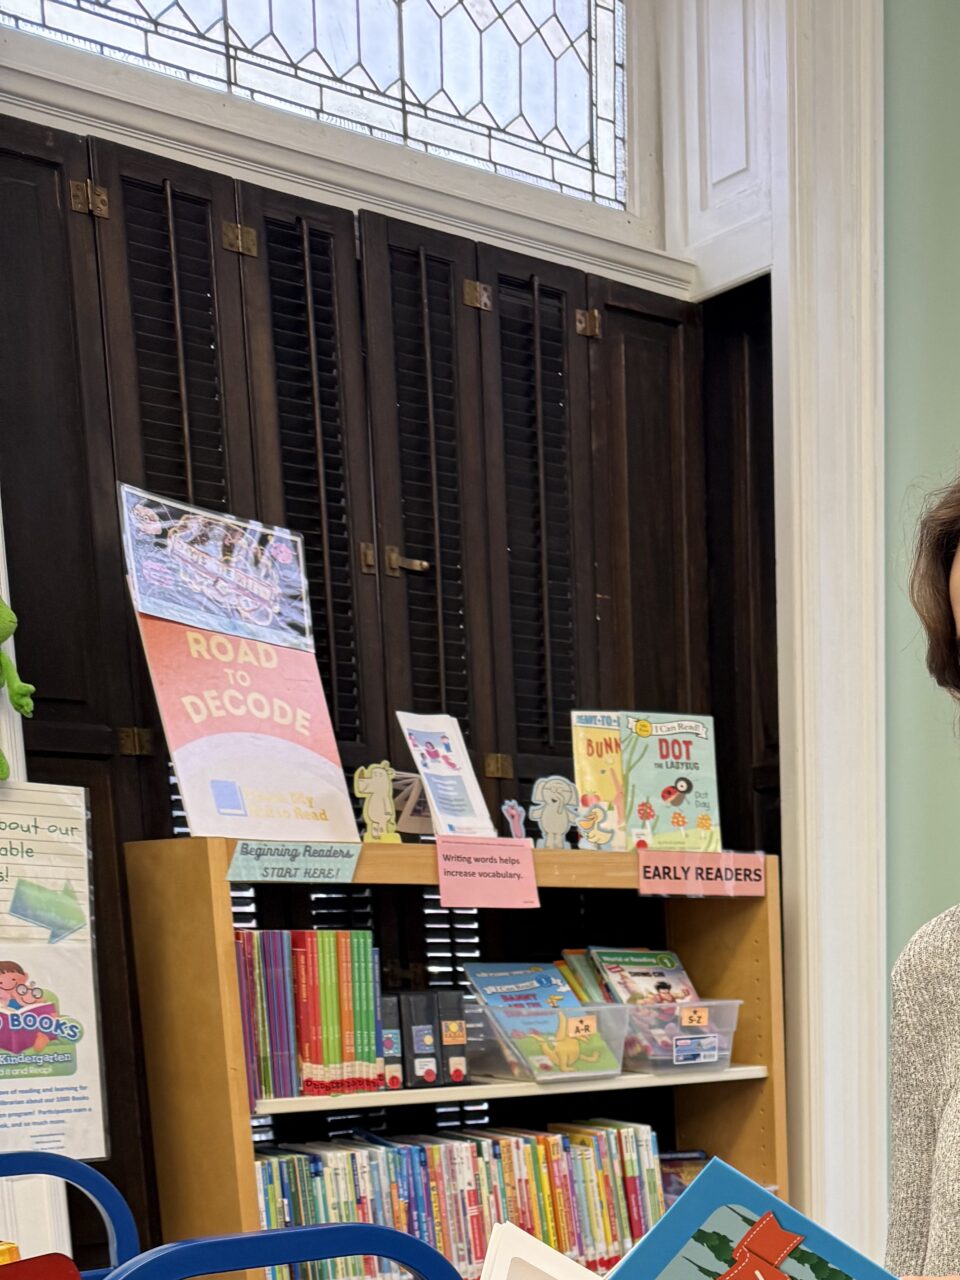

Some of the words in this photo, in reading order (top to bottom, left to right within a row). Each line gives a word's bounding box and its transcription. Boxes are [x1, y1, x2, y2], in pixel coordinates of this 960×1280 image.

[186, 630, 278, 669] ROAD
[224, 668, 251, 687] TO
[180, 689, 311, 736] DECODE
[657, 738, 693, 760] DOT
[665, 761, 700, 771] LADYBUG
[240, 842, 301, 862] Beginning
[302, 844, 354, 858] Readers
[442, 853, 472, 865] Writing
[474, 855, 498, 864] words
[499, 855, 521, 866] helps
[262, 866, 301, 879] START
[304, 867, 341, 879] HERE!
[444, 868, 476, 878] increase
[478, 869, 524, 880] vocabulary.
[643, 865, 691, 880] EARLY
[695, 866, 762, 882] READERS
[9, 1013, 80, 1040] BOOKS
[688, 1015, 703, 1025] S-Z
[574, 1023, 591, 1035] A-R
[0, 1052, 72, 1066] Kindergarten
